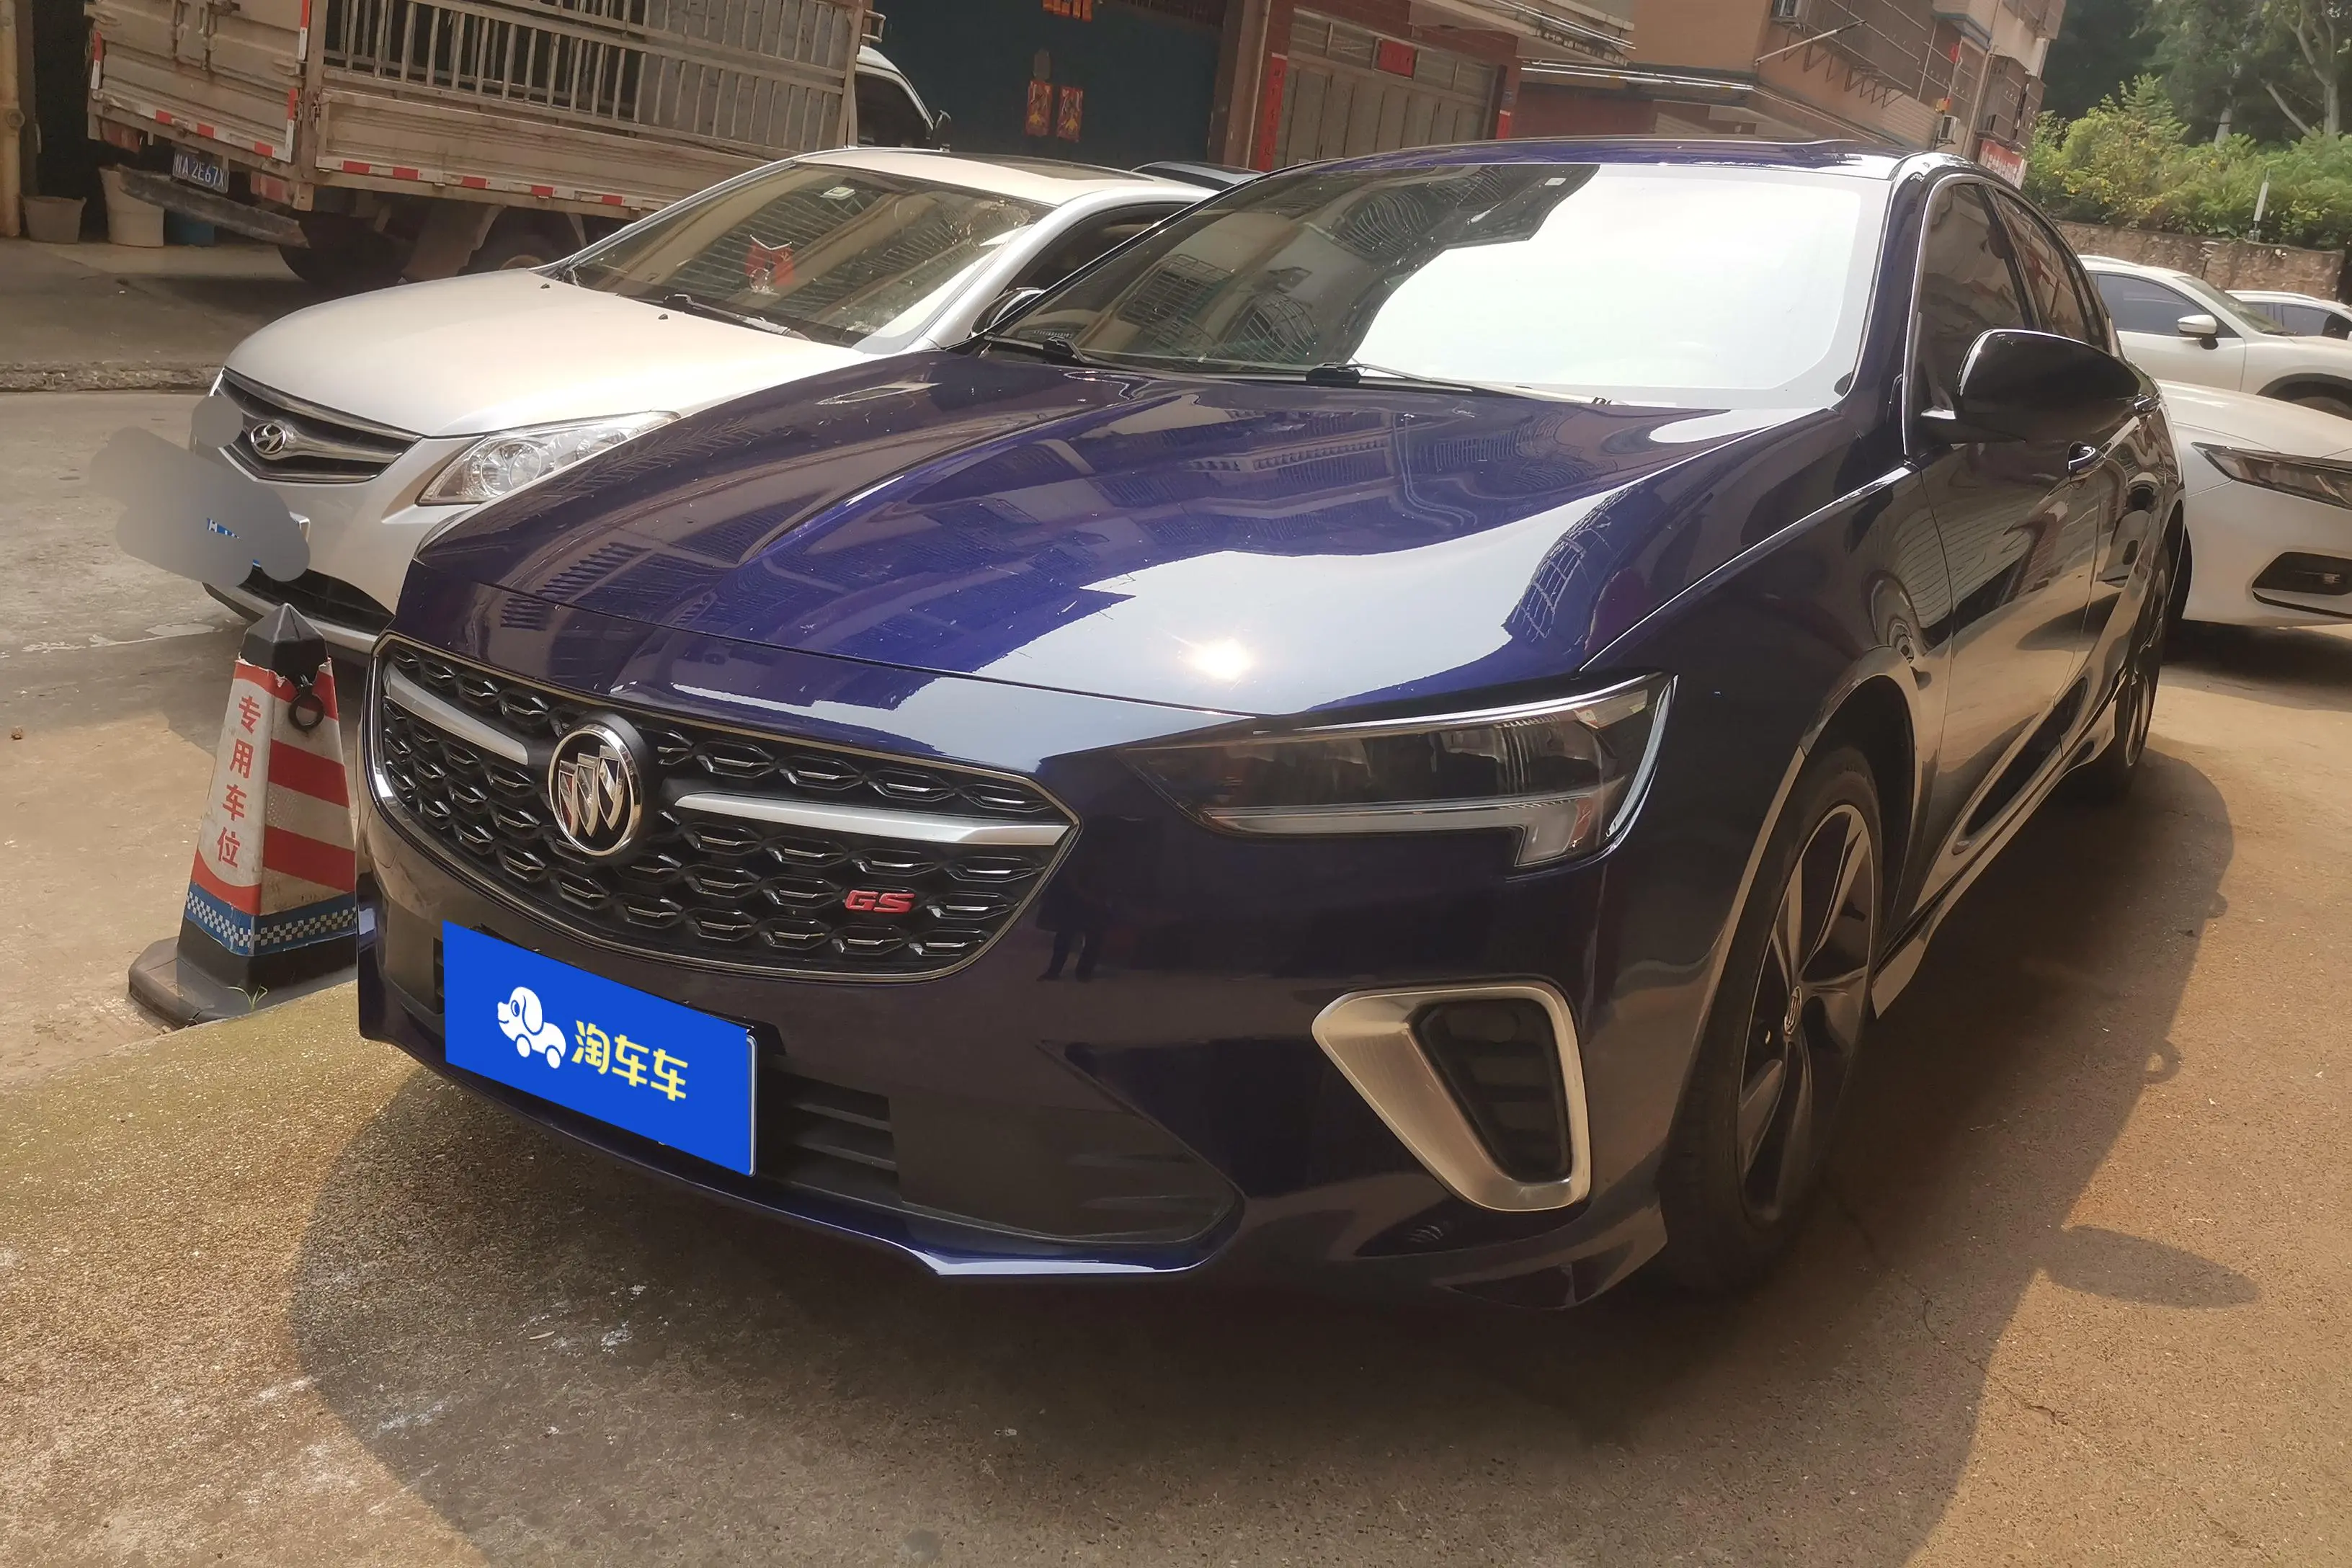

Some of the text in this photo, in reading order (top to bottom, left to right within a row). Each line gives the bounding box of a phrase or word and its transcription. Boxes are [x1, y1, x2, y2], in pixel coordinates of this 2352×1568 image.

[216, 695, 262, 868] 专用车位
[845, 889, 915, 913] GS
